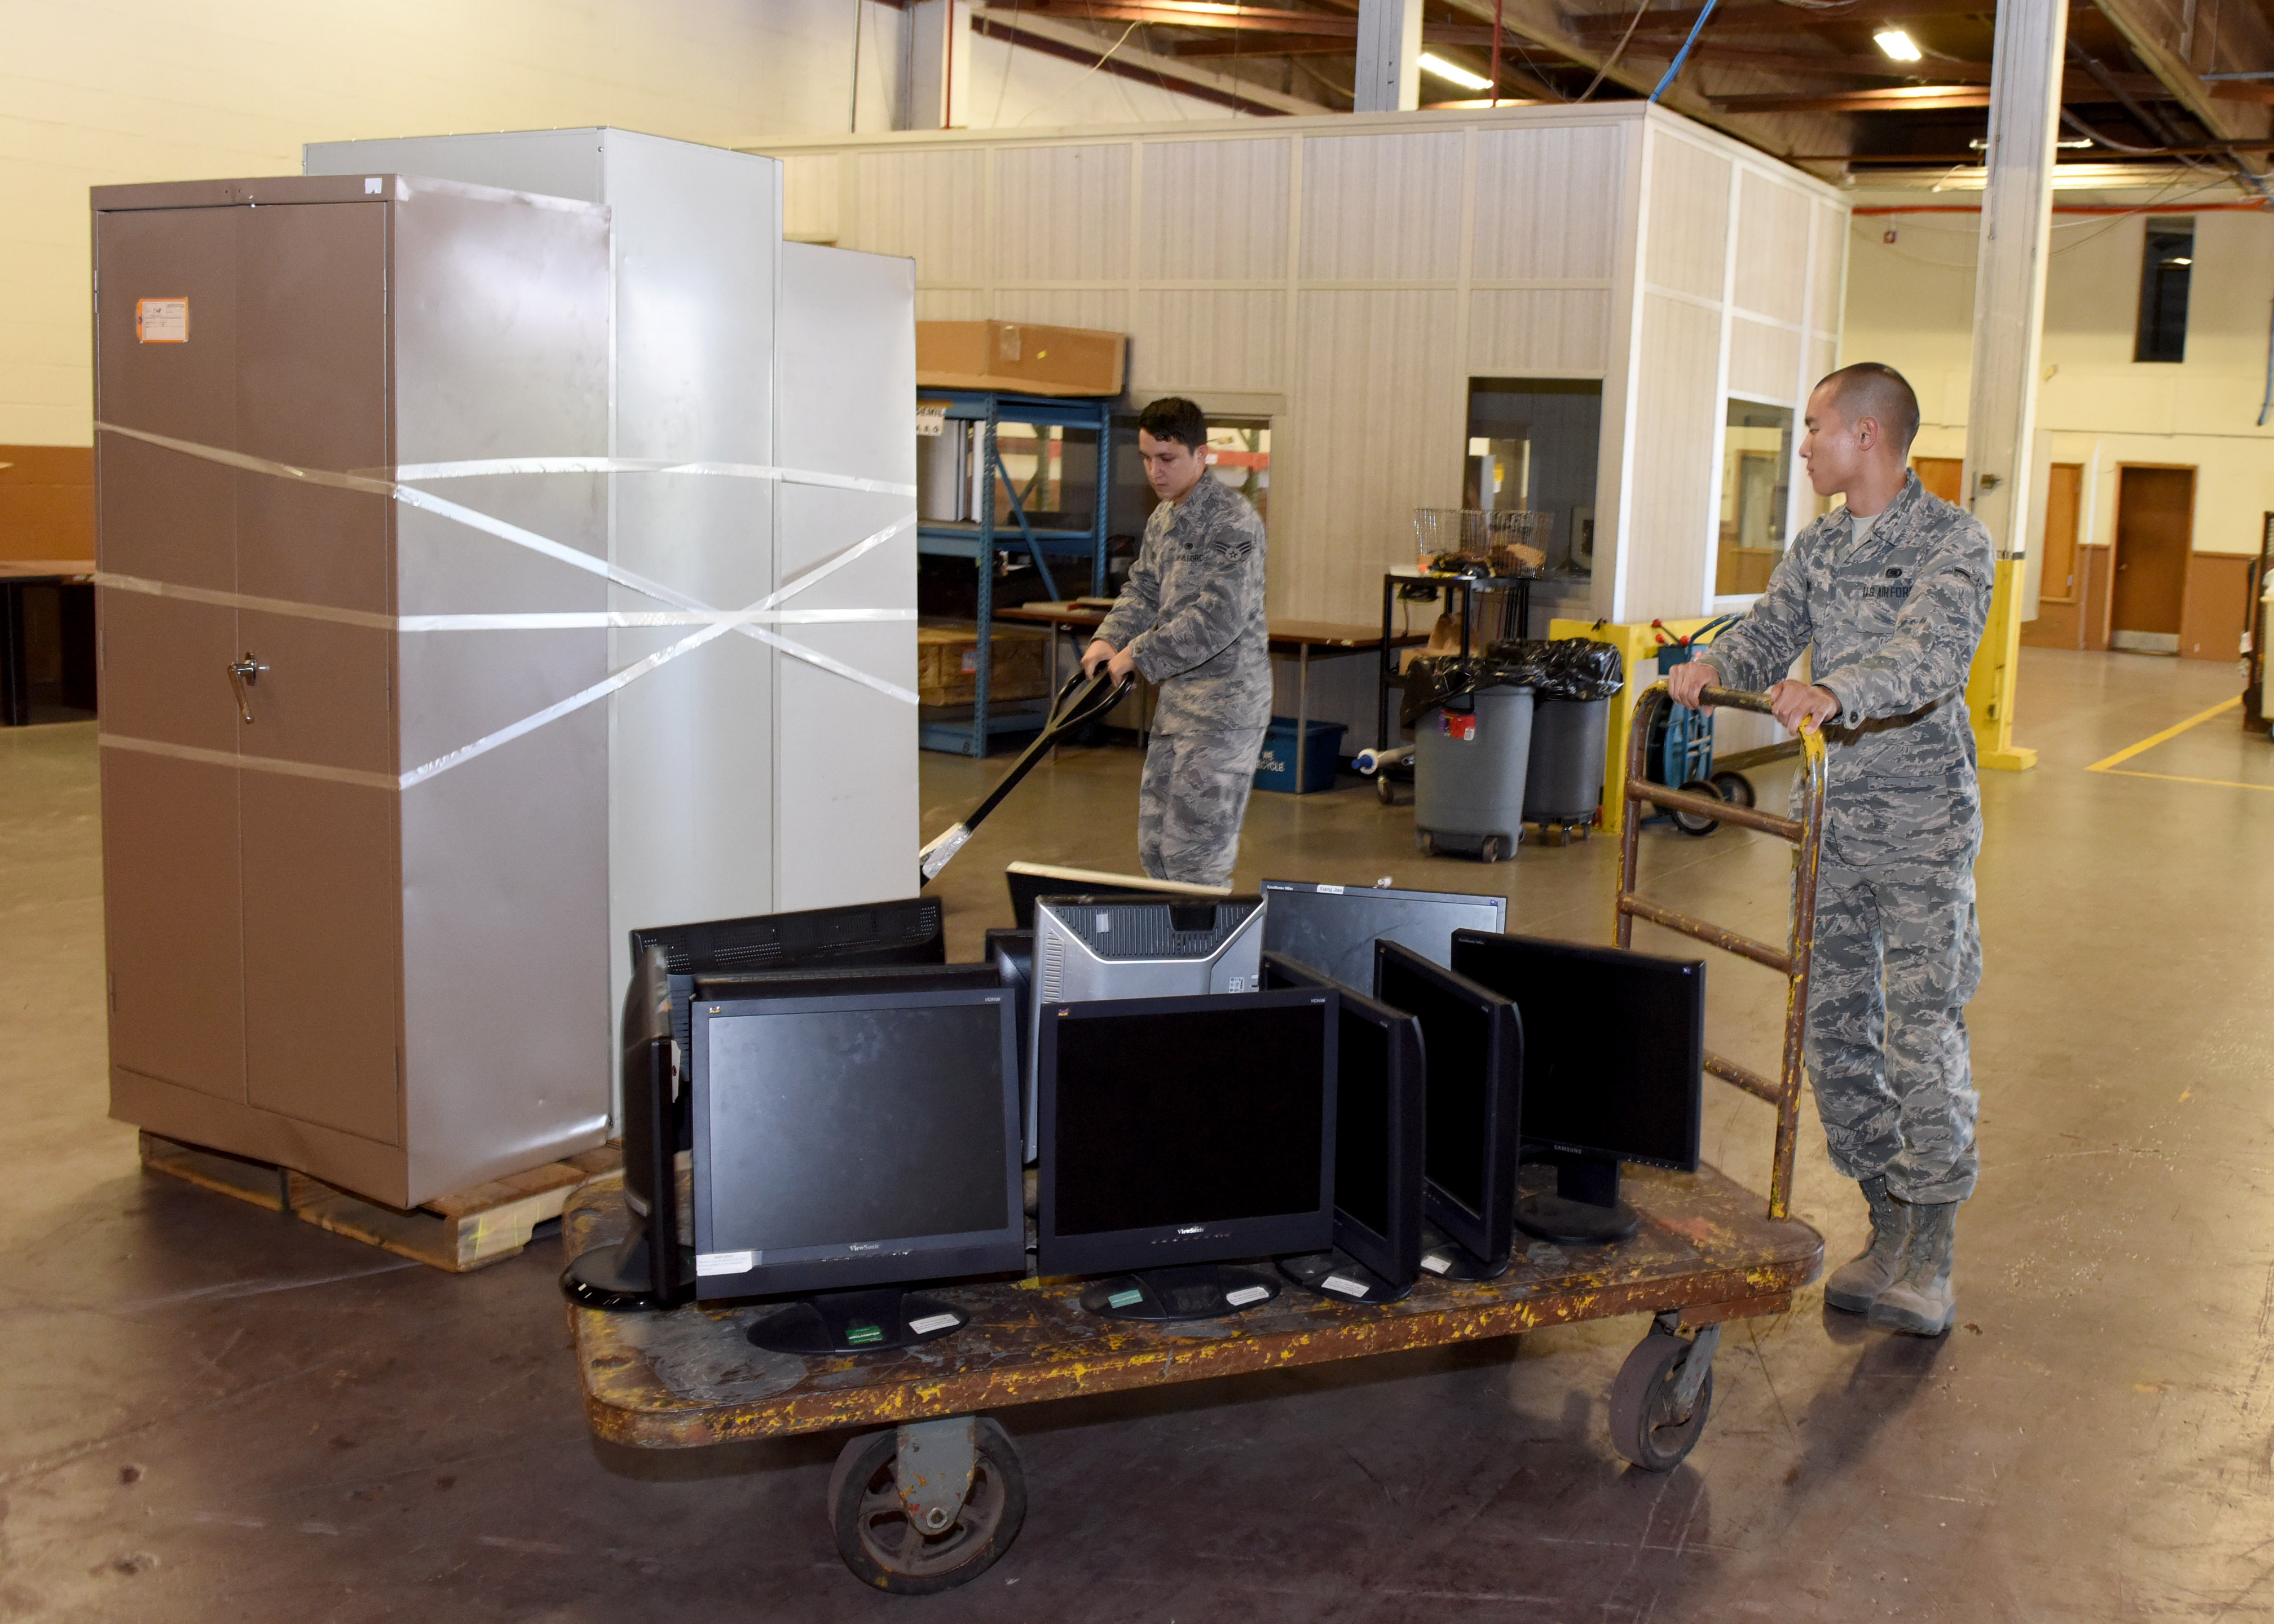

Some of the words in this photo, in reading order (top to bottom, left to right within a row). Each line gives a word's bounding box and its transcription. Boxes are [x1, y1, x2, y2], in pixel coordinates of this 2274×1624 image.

[1876, 586, 1889, 598] AIR
[1890, 586, 1913, 598] FOR
[1554, 1145, 1582, 1154] SAMSUNG
[849, 1243, 880, 1251] ViewSonic
